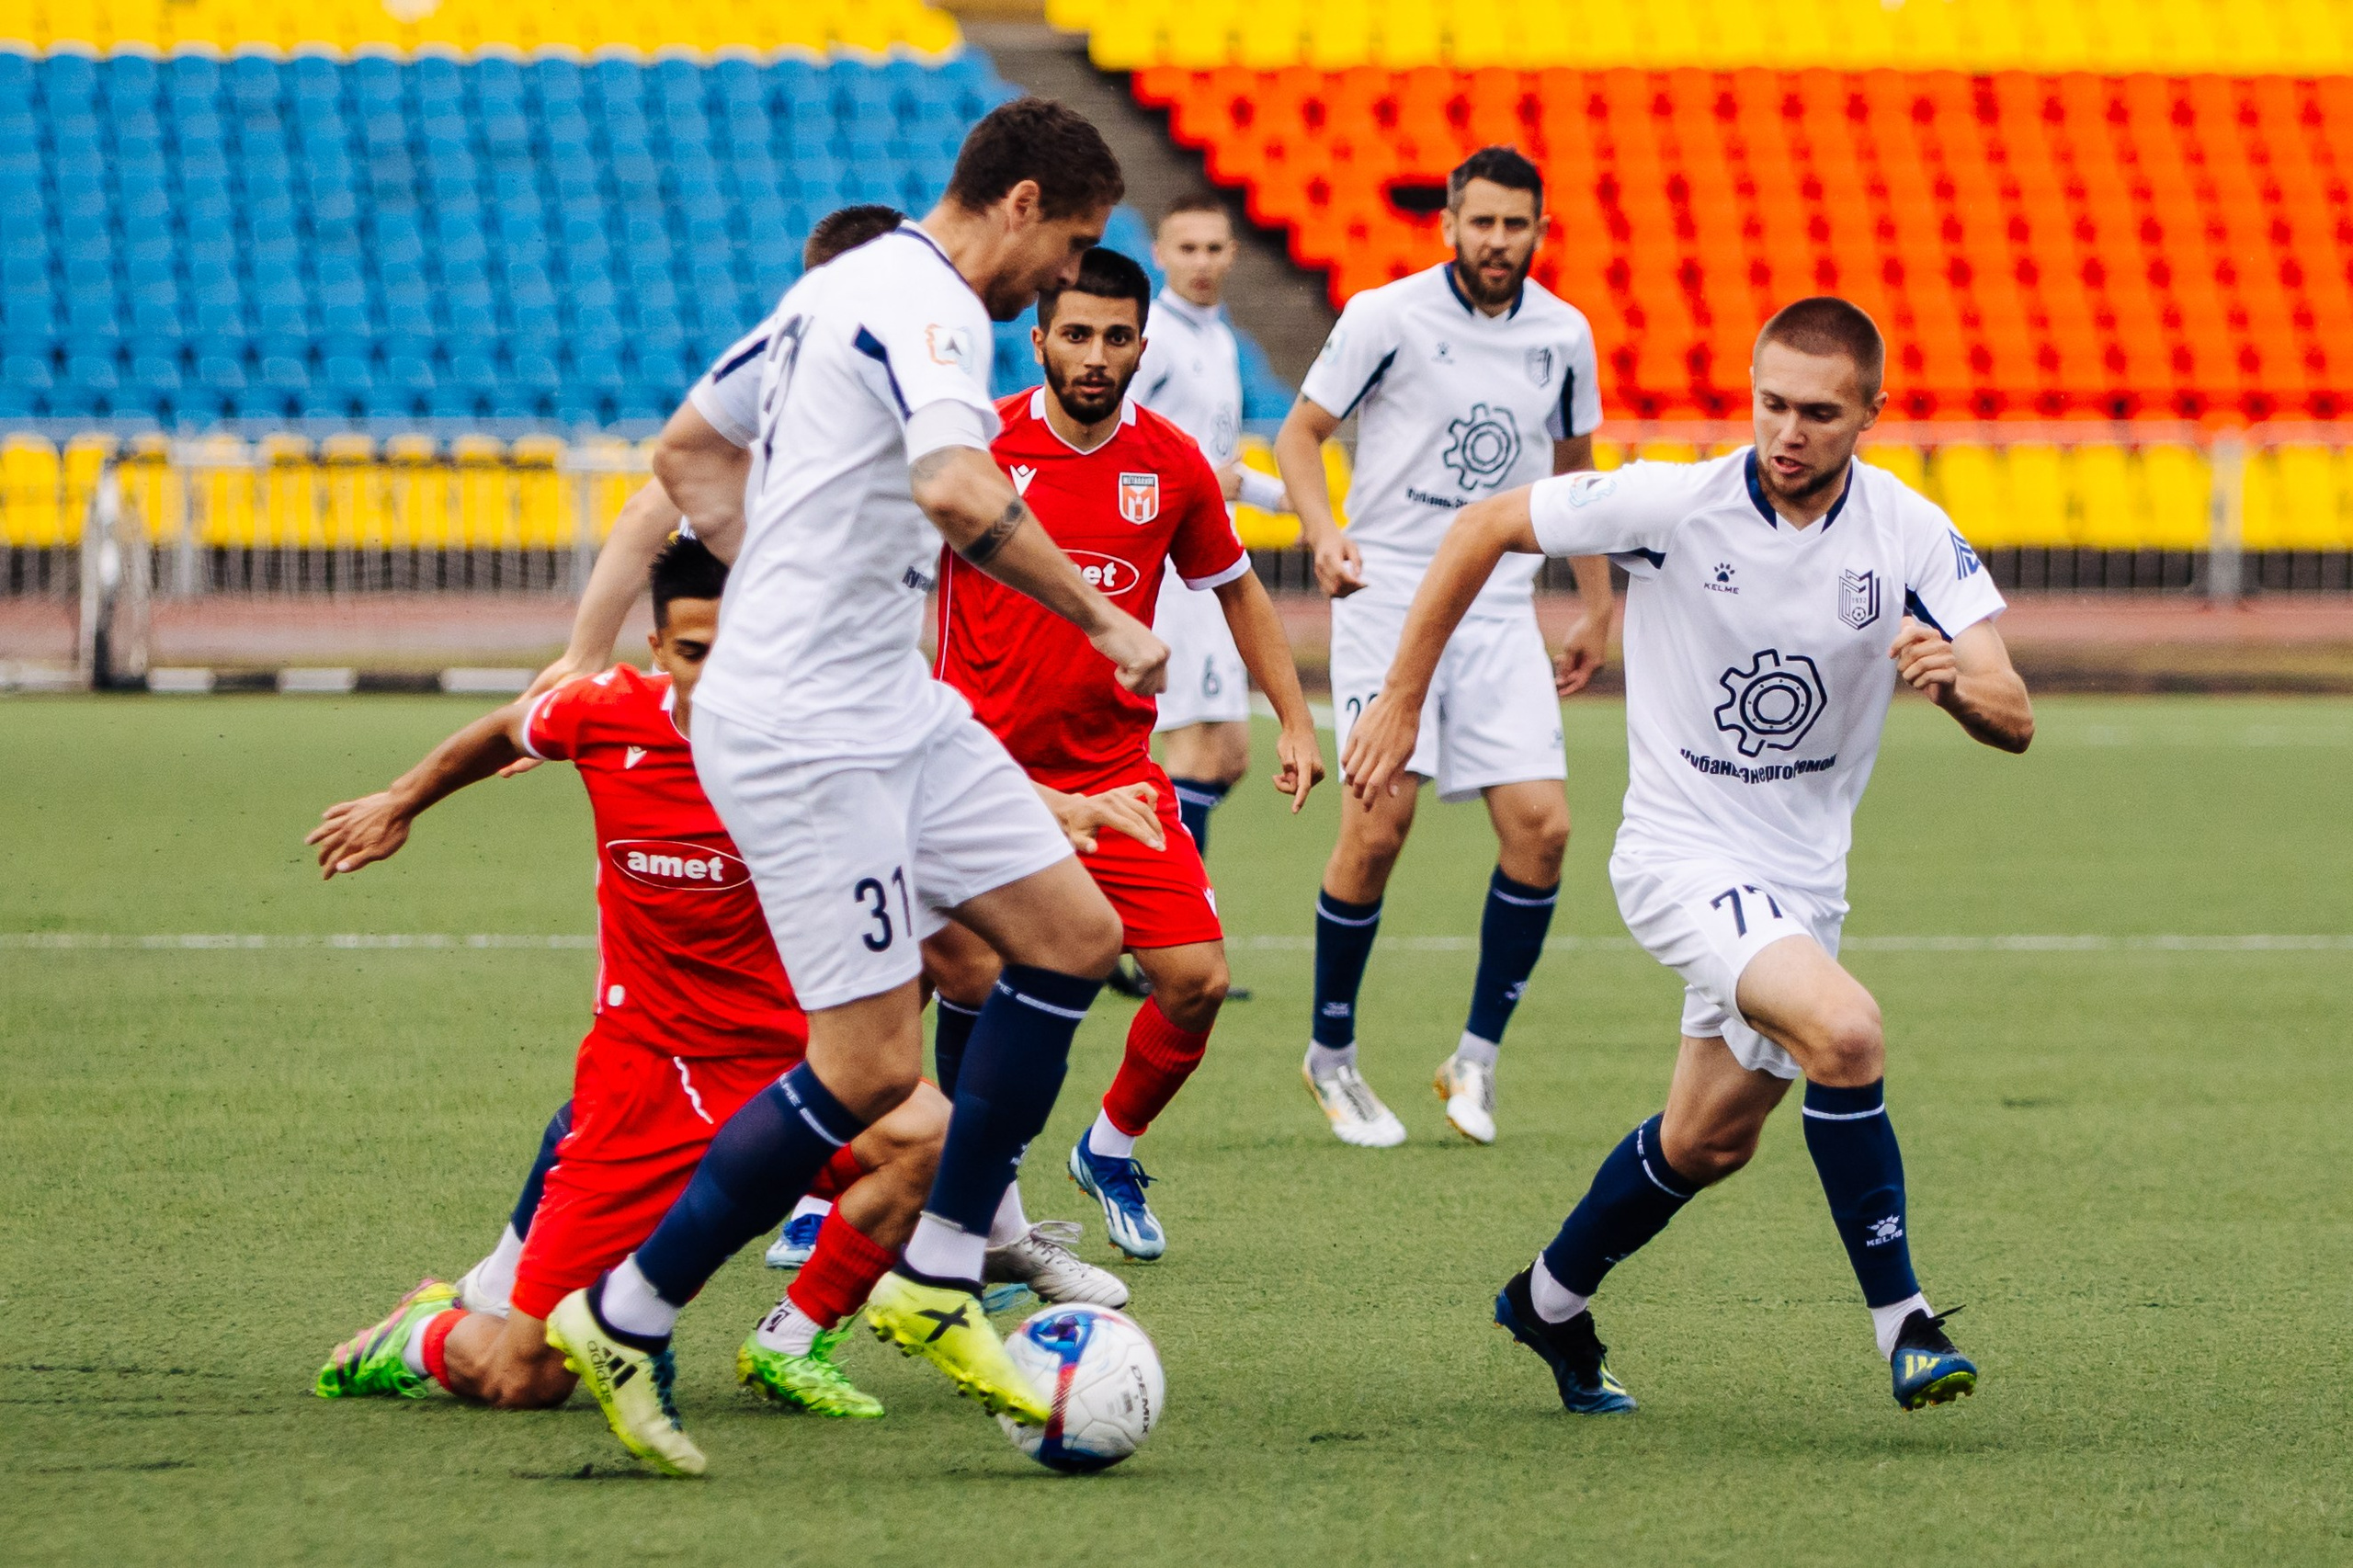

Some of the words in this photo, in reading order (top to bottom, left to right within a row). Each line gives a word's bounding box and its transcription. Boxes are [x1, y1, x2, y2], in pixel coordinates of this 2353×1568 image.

[1072, 562, 1118, 587] et
[1704, 582, 1740, 595] KELME
[1201, 653, 1222, 700] 6
[627, 851, 724, 882] amet
[854, 865, 913, 952] 31
[1709, 884, 1783, 938] 77
[1866, 1229, 1904, 1247] KELME
[587, 1340, 613, 1403] adidas
[1131, 1365, 1150, 1434] DEMIX
